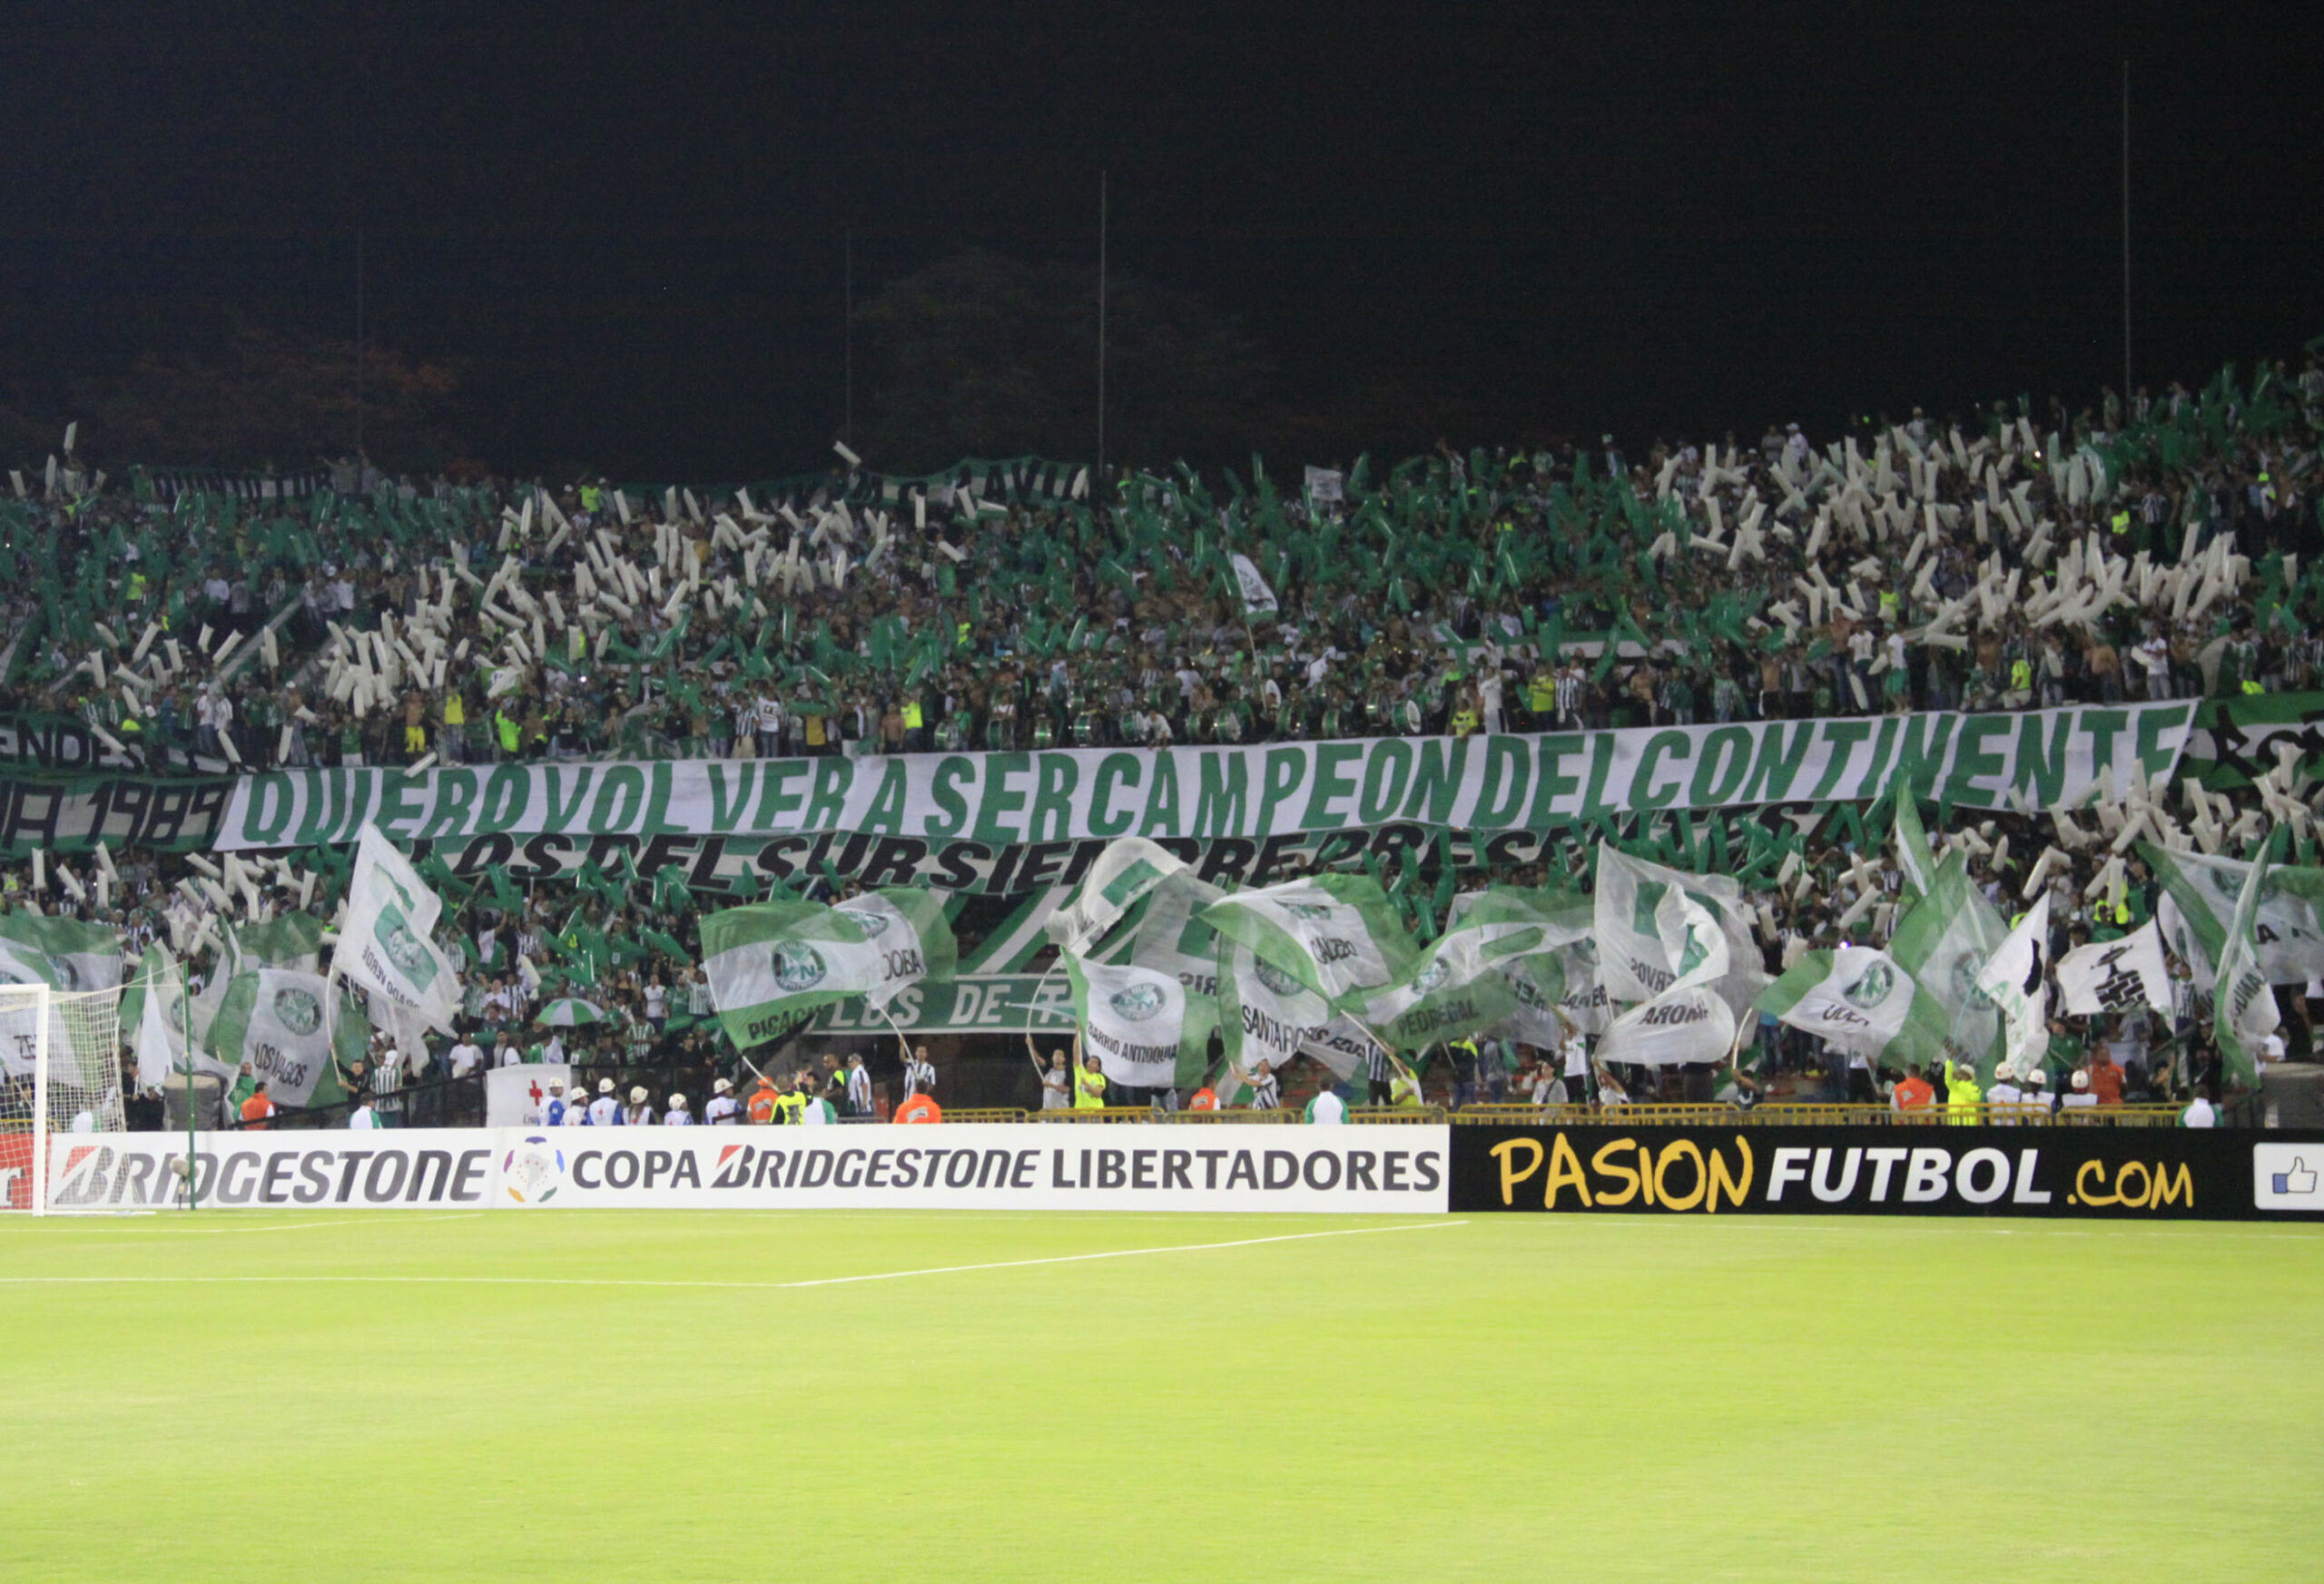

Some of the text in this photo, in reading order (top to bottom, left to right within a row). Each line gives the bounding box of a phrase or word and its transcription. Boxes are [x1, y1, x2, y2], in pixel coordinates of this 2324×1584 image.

[242, 764, 532, 846] QUIERO
[857, 758, 907, 836] A
[924, 752, 1079, 842] SER
[1087, 736, 1471, 837] CAMPEON
[1468, 732, 1621, 828] DEL
[1627, 704, 2190, 807] CONTINENTE
[84, 778, 234, 847] 1989
[757, 831, 928, 886] SUR
[949, 983, 1012, 1025] DE
[1088, 1020, 1120, 1056] BARRIO
[54, 1145, 491, 1205] BRIDGESTONE
[572, 1144, 1441, 1192] COPA BRIDGESTONE LIBERTADORES
[1490, 1132, 1753, 1213] PASION
[1766, 1147, 2052, 1205] FUTBOL
